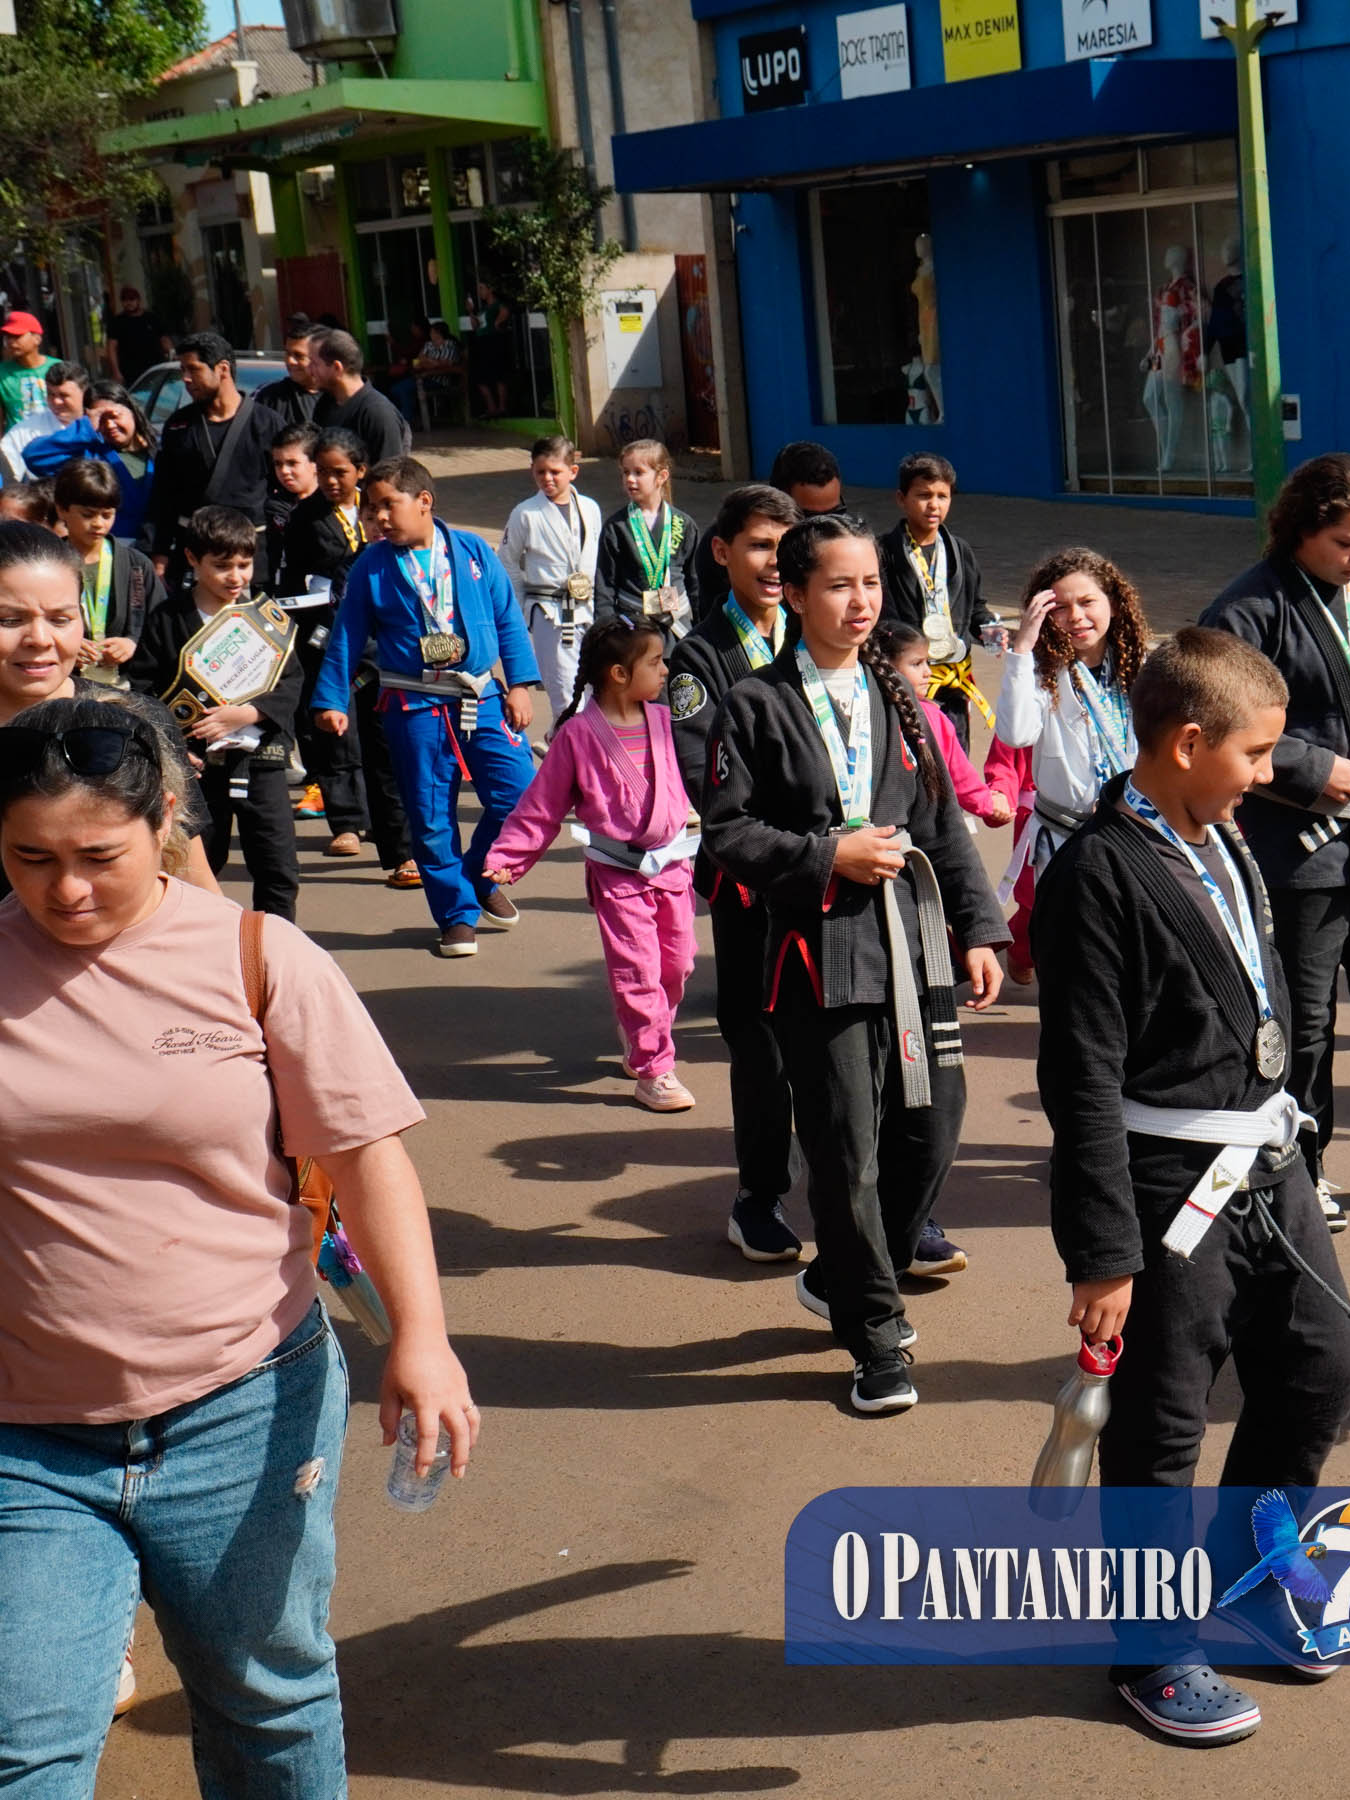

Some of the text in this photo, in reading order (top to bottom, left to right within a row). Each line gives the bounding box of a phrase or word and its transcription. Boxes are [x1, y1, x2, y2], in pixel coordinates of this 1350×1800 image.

[944, 16, 1016, 42] MAX DENIM
[1077, 21, 1138, 52] MARESIA
[840, 29, 906, 69] DOCE TRAMA
[742, 47, 801, 96] LUPO
